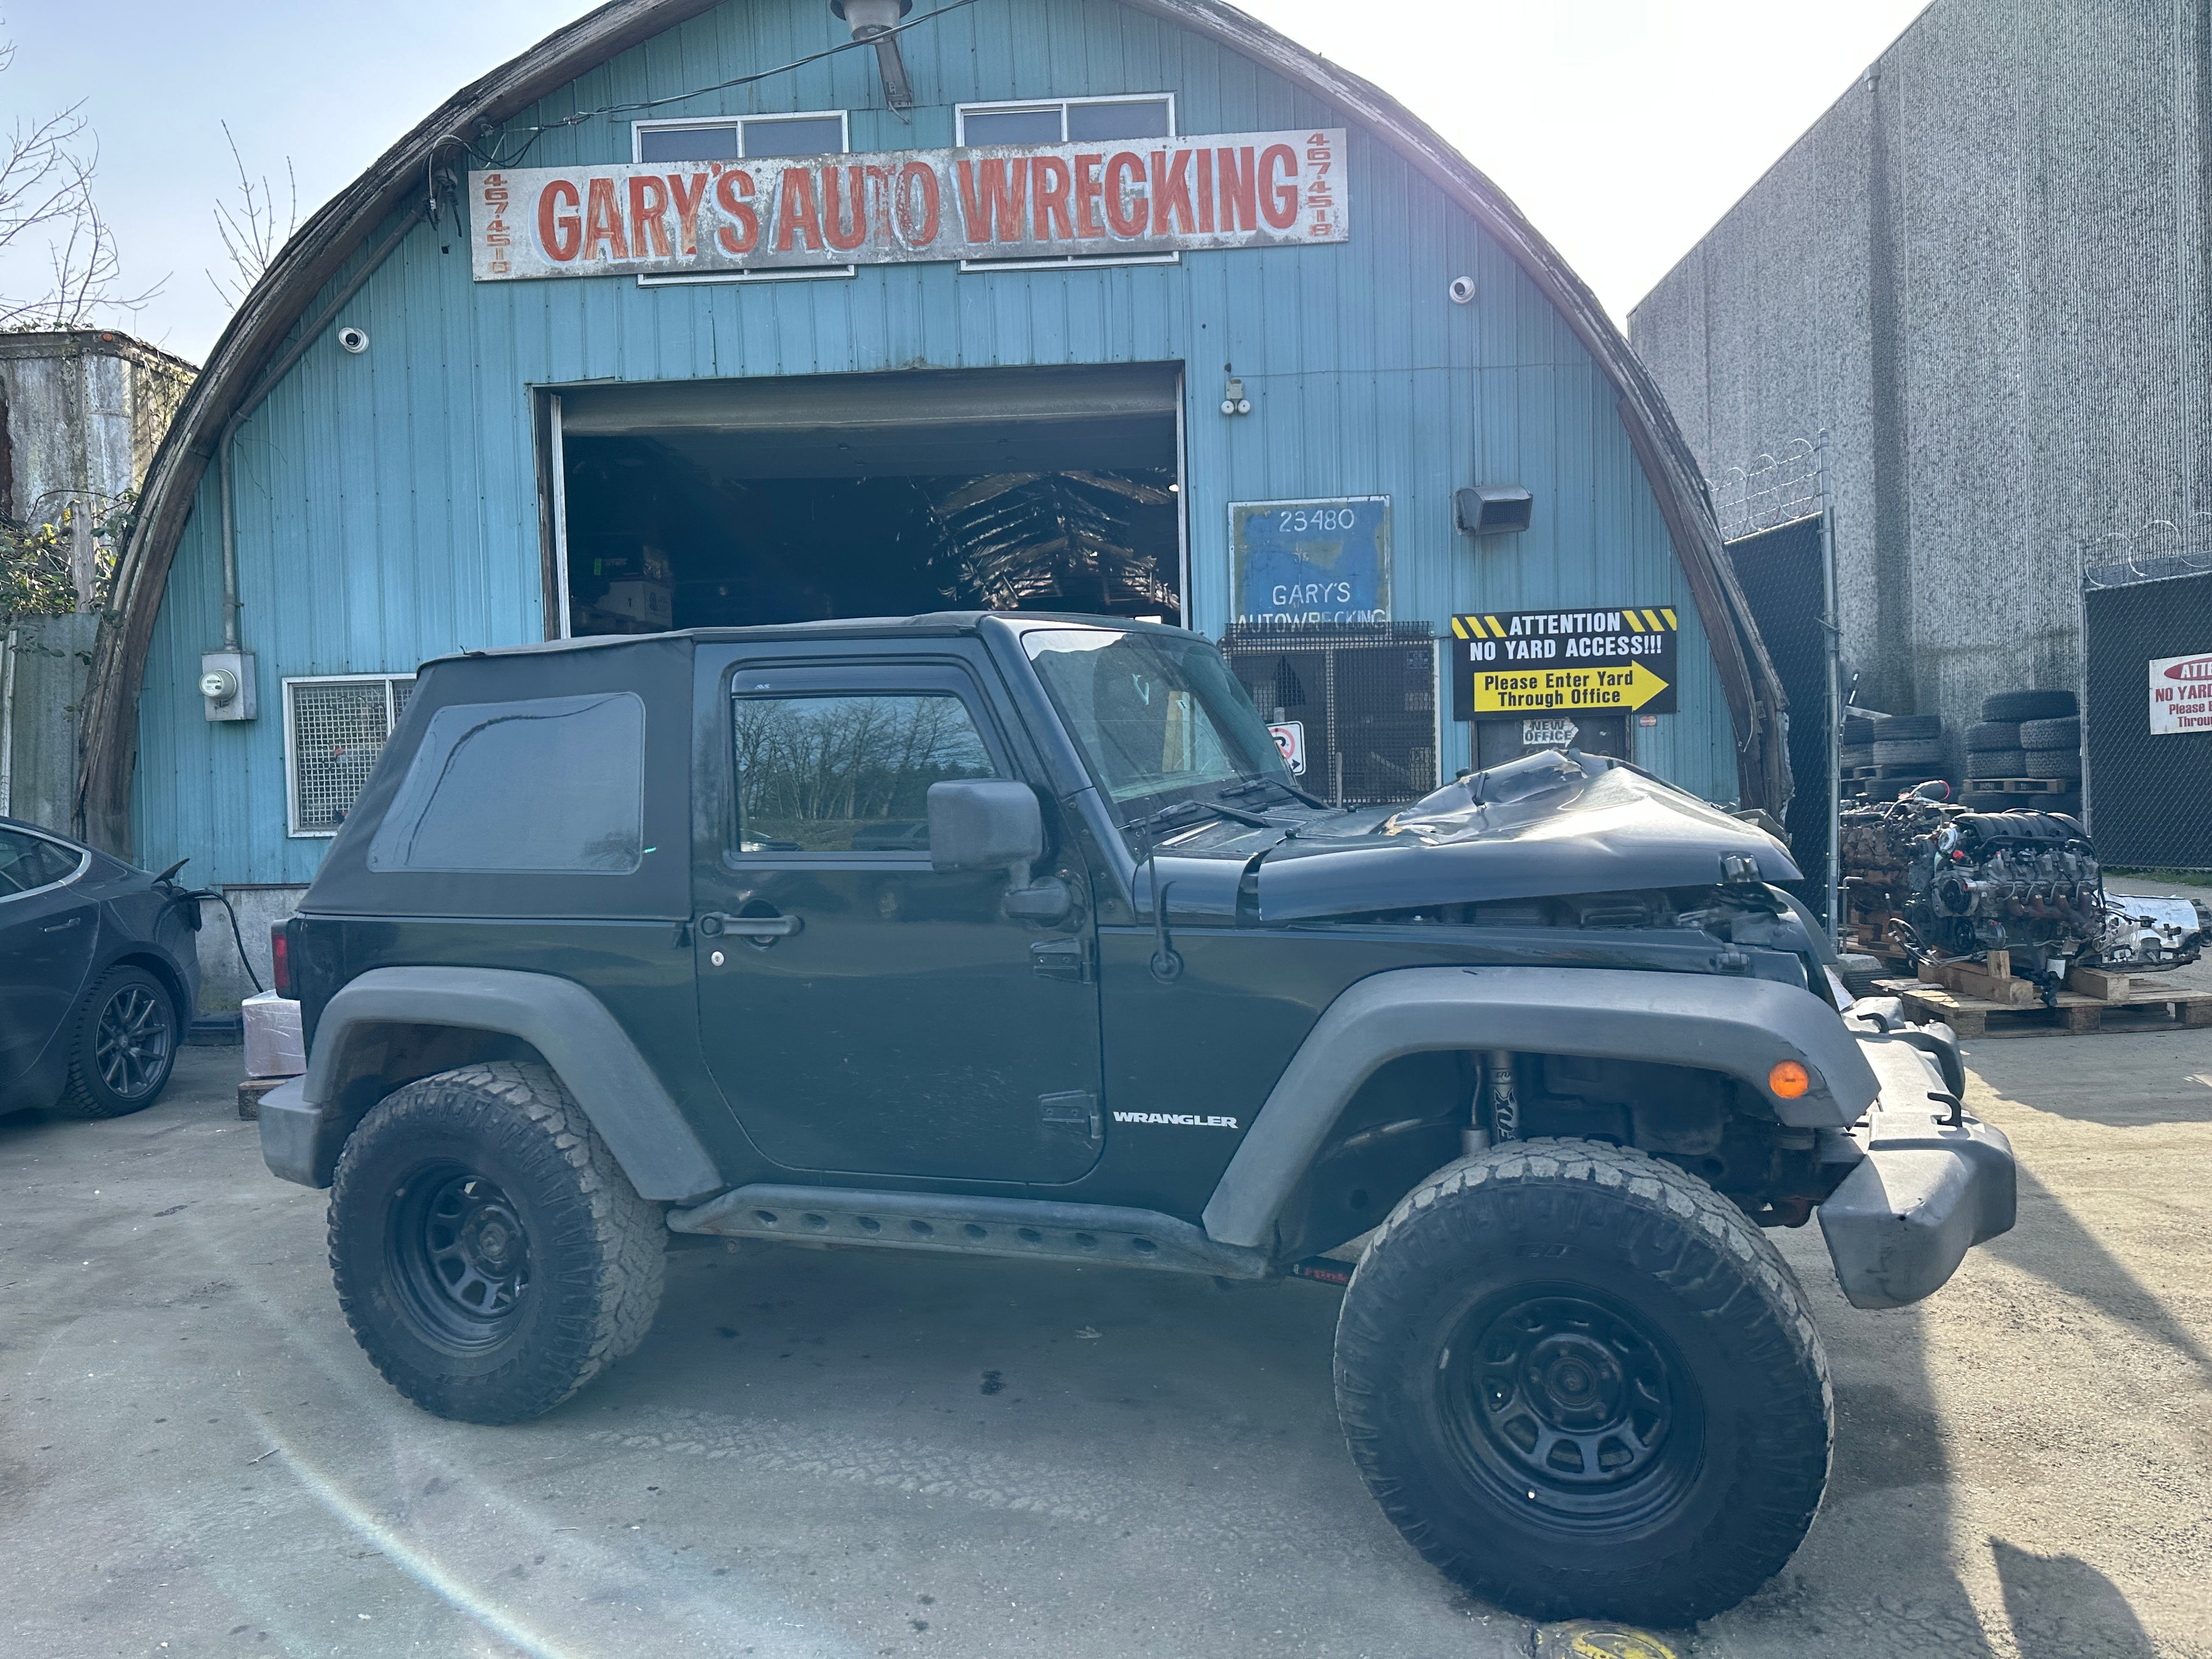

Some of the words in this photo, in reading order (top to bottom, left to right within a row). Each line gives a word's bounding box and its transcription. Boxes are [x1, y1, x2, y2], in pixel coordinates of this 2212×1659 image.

[536, 162, 759, 263] GARY'S
[775, 161, 940, 252] AUTO
[956, 143, 1299, 243] WRECKING
[1279, 508, 1355, 532] 23480
[1272, 582, 1351, 605] GARY'S
[1509, 612, 1620, 636] ATTENTION
[1470, 641, 1496, 661] NO
[1505, 639, 1556, 660] YARD
[1565, 635, 1662, 657] ACCESS!!!
[1484, 676, 1537, 691] Please
[1546, 673, 1589, 688] Enter
[1597, 670, 1633, 686] Yard
[1498, 688, 1563, 708] Through
[1571, 689, 1620, 704] Office
[2156, 687, 2173, 702] NO
[2169, 703, 2205, 715] Please
[1531, 719, 1565, 730] NEW
[1525, 729, 1572, 741] OFFICE
[1113, 1111, 1238, 1129] WRANGLER
